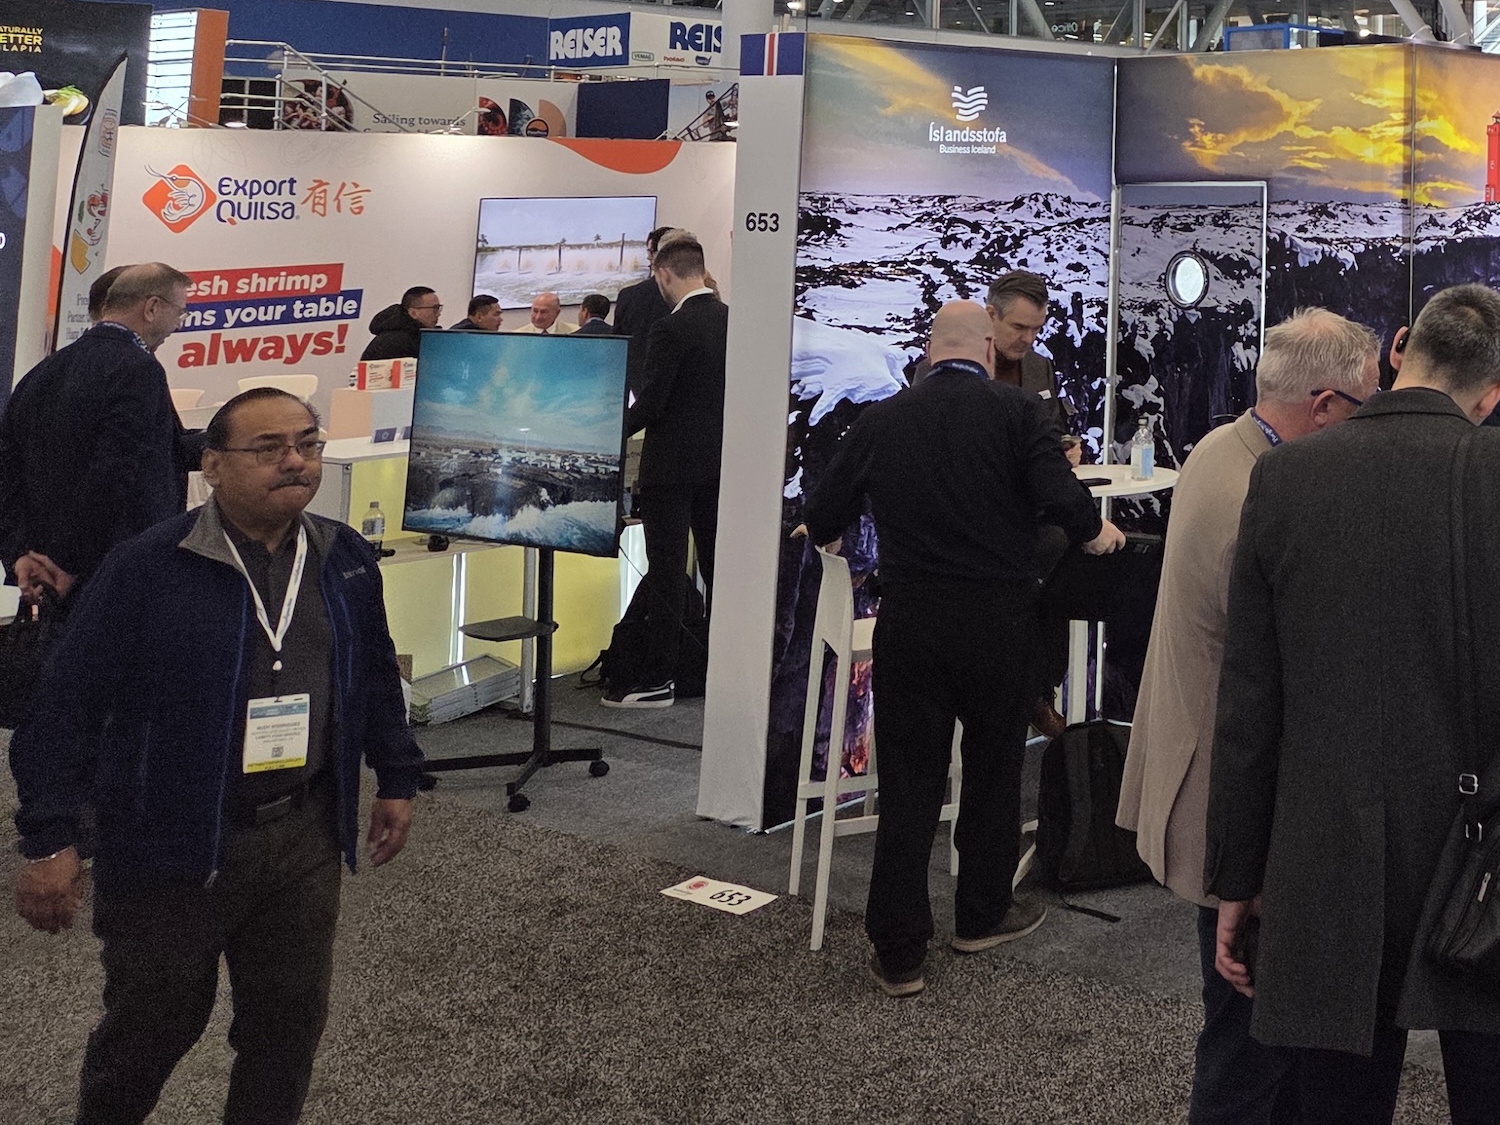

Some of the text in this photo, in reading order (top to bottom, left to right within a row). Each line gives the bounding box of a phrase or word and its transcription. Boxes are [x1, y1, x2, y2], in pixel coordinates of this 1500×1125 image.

[550, 25, 623, 60] REISER
[669, 21, 721, 53] REIS
[373, 113, 466, 127] Sailing towards
[929, 122, 1007, 142] Íslandsstofa
[939, 144, 996, 154] Business Iceland
[218, 177, 297, 199] Export
[301, 179, 372, 217] 有信
[746, 212, 779, 232] 653
[235, 271, 327, 294] shrimp
[223, 304, 286, 328] your
[293, 296, 357, 318] table
[178, 324, 349, 368] always!
[709, 889, 752, 906] 653
